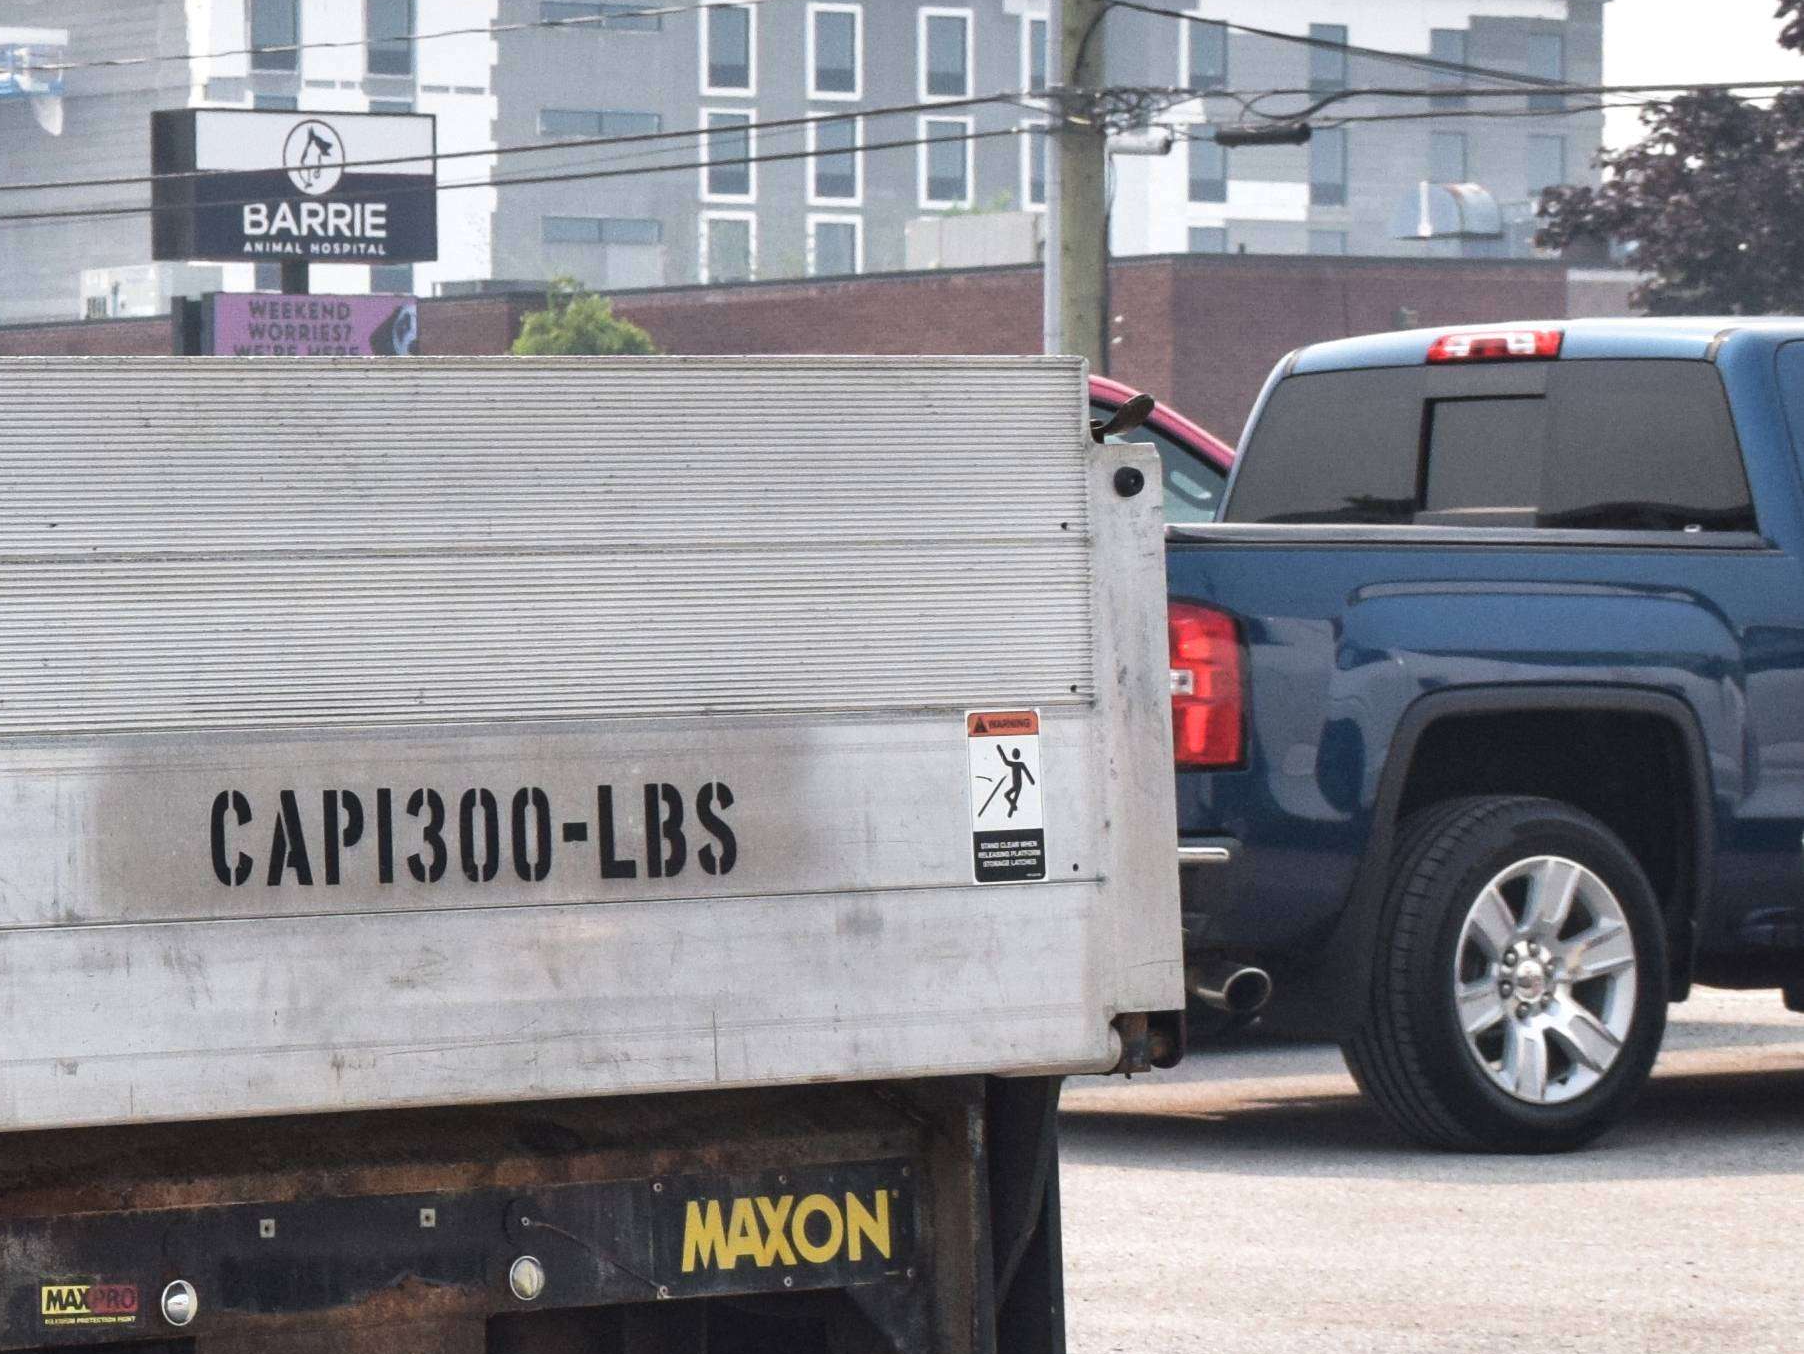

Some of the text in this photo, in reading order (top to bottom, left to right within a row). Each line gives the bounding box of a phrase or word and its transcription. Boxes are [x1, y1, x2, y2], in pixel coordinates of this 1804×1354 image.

[243, 202, 387, 238] BARRIE
[244, 241, 386, 255] ANIMAL HOSPITAL
[248, 301, 351, 320] WEEKEND
[248, 323, 353, 342] WORRIES?
[989, 718, 1032, 729] WARNING
[681, 1189, 891, 1272] MAXON
